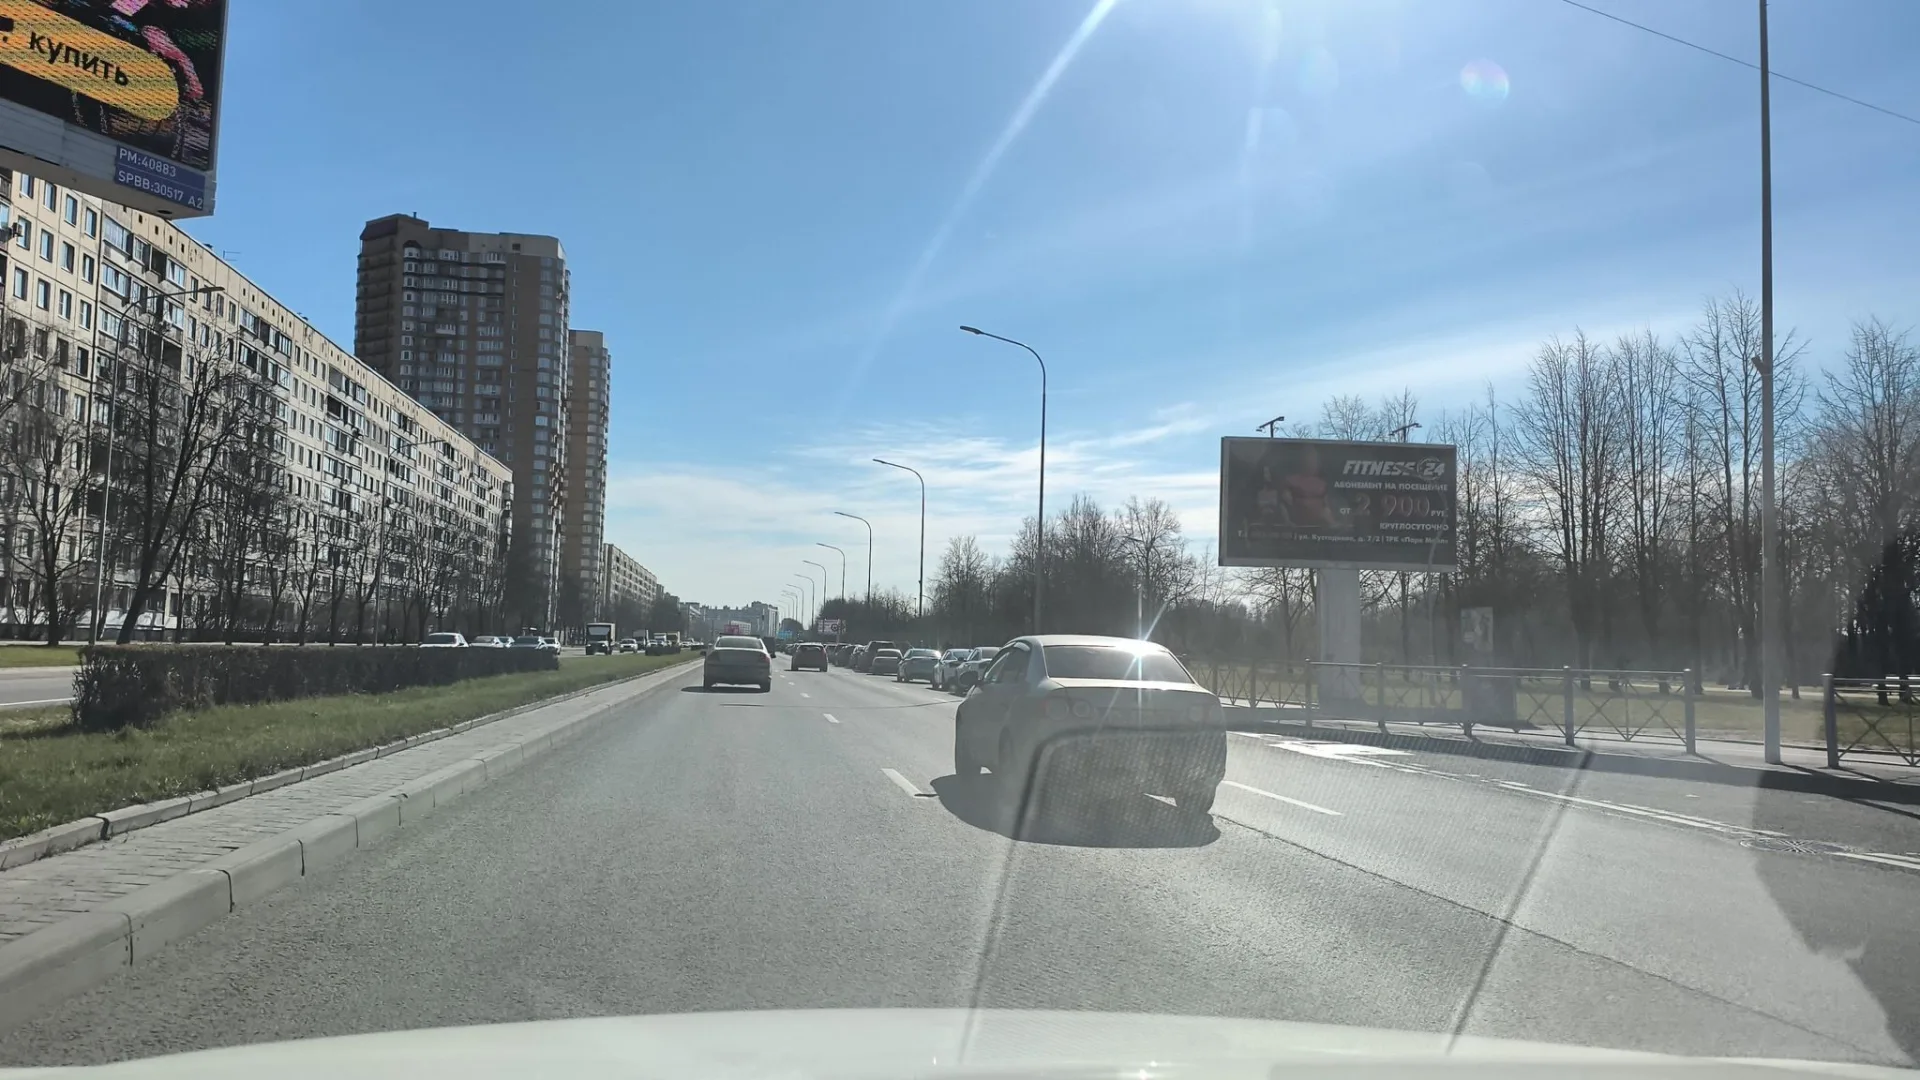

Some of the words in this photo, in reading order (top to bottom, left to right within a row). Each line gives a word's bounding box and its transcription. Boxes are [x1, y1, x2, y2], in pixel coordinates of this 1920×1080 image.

[30, 32, 129, 86] купить
[119, 148, 177, 178] PM:40883
[118, 170, 184, 201] SPBB:30517
[188, 197, 204, 210] A2
[1343, 460, 1416, 476] FITNESS
[1423, 462, 1446, 477] 24
[1334, 480, 1382, 490] АБОНЕМЕНТ
[1385, 482, 1397, 490] НА
[1399, 483, 1449, 492] ПОСЕЩЕНИЕ
[1379, 522, 1449, 533] КРУГЛОСУТОЧНО
